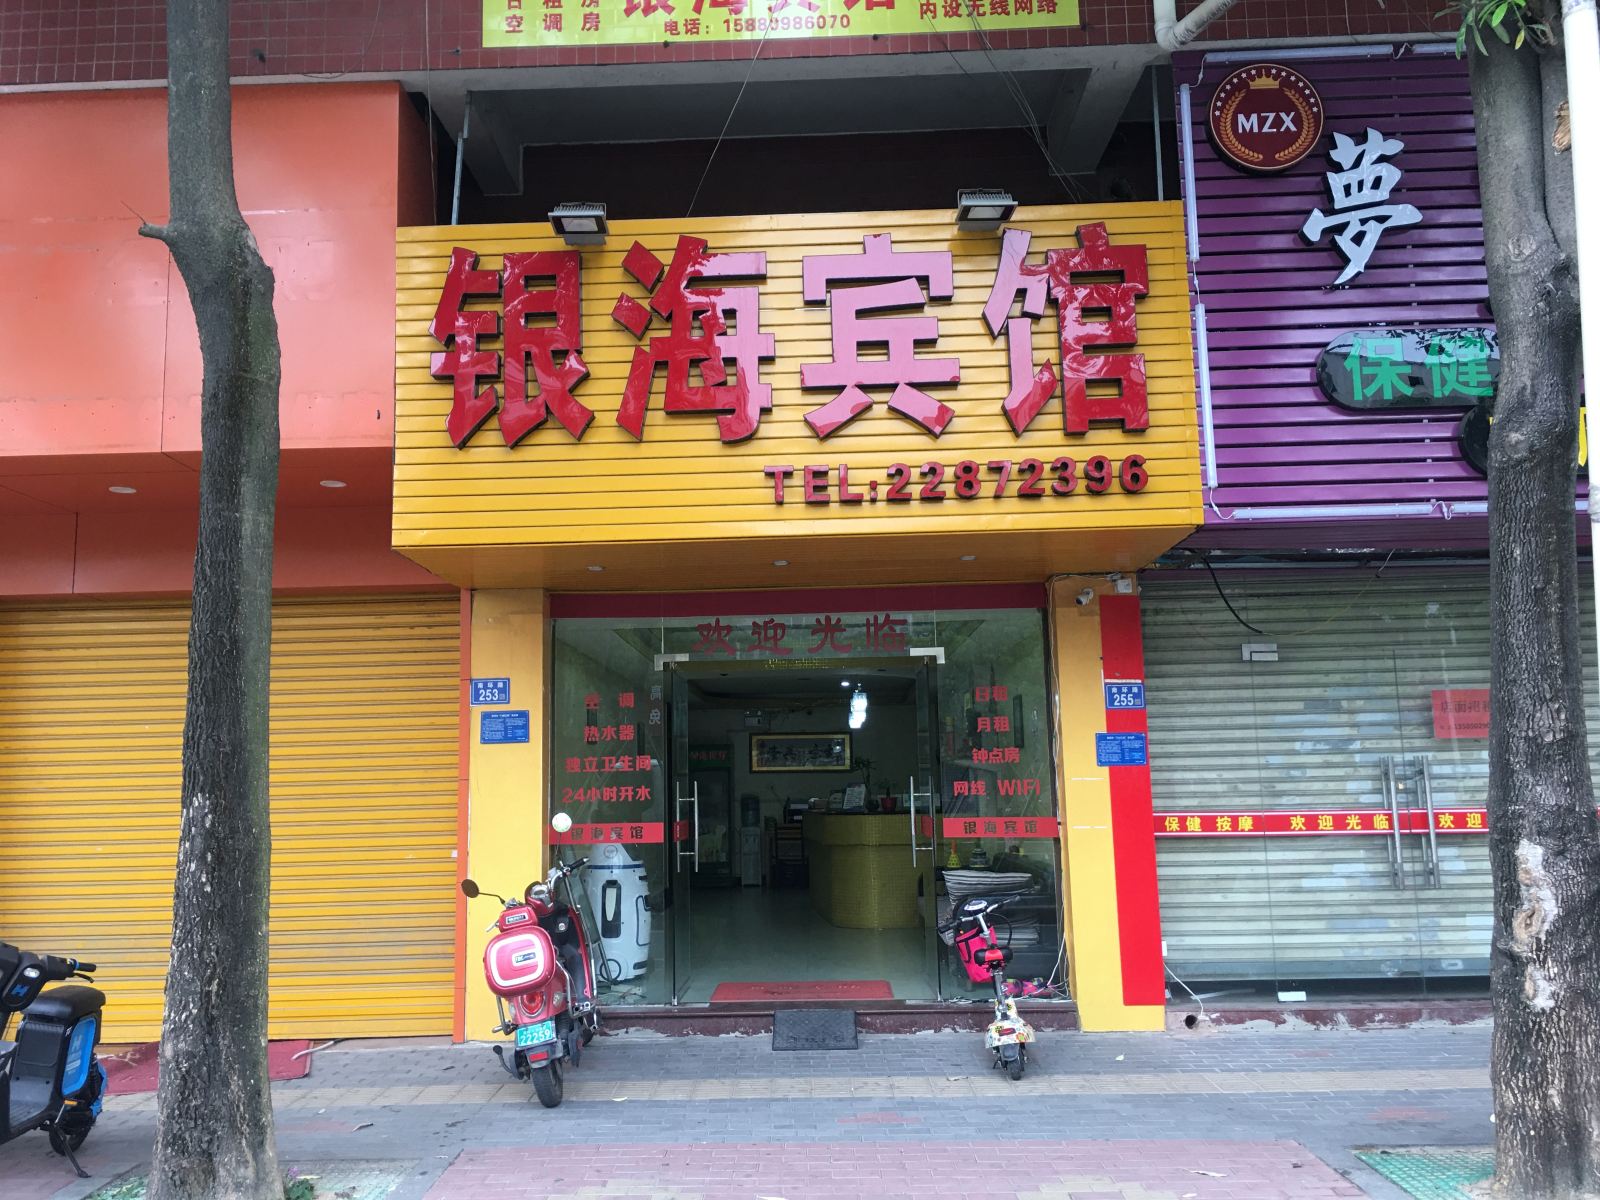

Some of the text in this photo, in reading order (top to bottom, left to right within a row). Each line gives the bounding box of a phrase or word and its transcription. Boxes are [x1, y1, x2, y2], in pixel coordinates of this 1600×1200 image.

[505, 12, 600, 33] 空调房
[1237, 111, 1298, 133] MZX
[429, 221, 1151, 449] 银海宾馆
[763, 453, 1150, 505] TEL:22872396
[690, 612, 909, 657] 欢迎光临
[975, 685, 1009, 702] 日租
[976, 716, 1010, 733] 月租
[583, 725, 636, 743] 热水器
[564, 755, 652, 773] 独立卫生间
[972, 746, 1021, 764] 钟点房
[561, 786, 652, 803] 24小时开水
[953, 780, 987, 796] 网线
[963, 820, 1038, 835] 银海宾馆
[1164, 812, 1483, 832] 保健按摩 欢迎光临 欢迎
[571, 825, 644, 841] 银海宾馆
